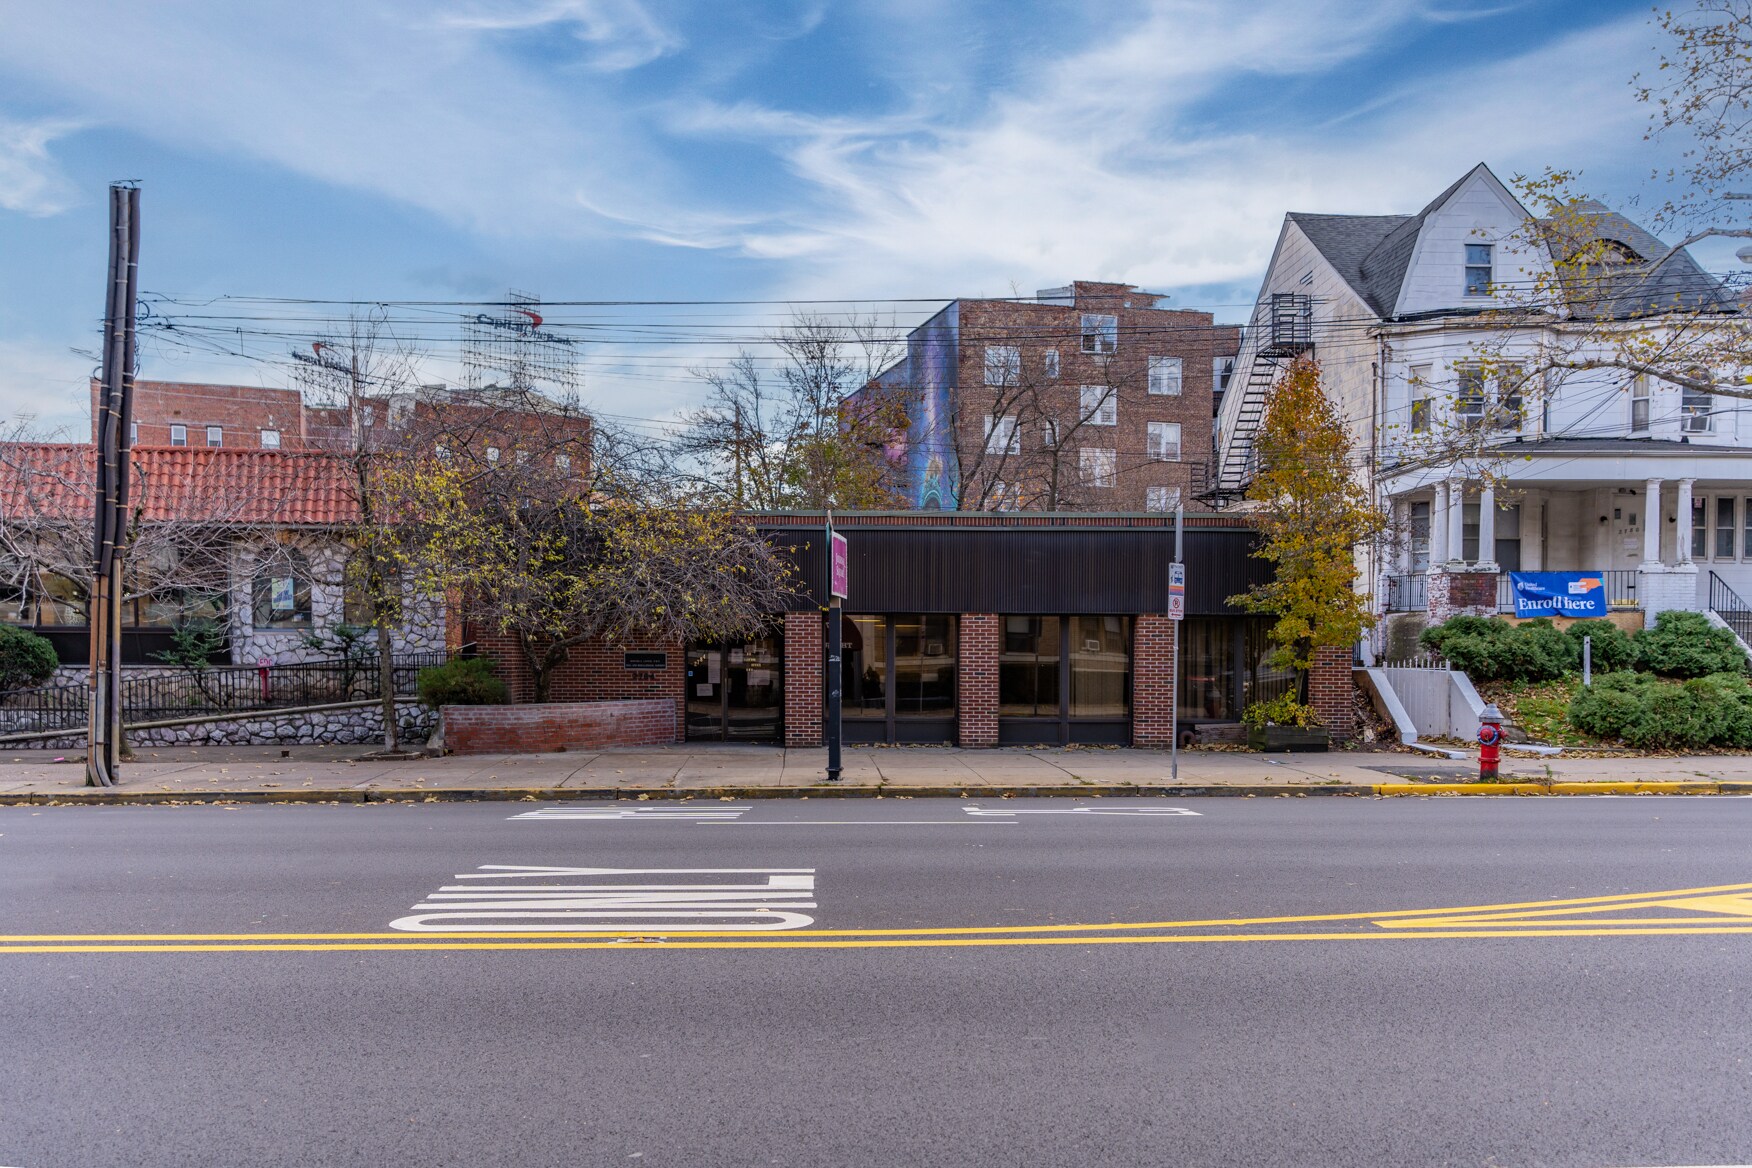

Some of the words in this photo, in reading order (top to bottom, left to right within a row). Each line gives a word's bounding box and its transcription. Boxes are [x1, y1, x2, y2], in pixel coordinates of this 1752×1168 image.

[1518, 595, 1562, 610] Enroll
[1563, 597, 1596, 610] here
[388, 864, 818, 931] ONLY
